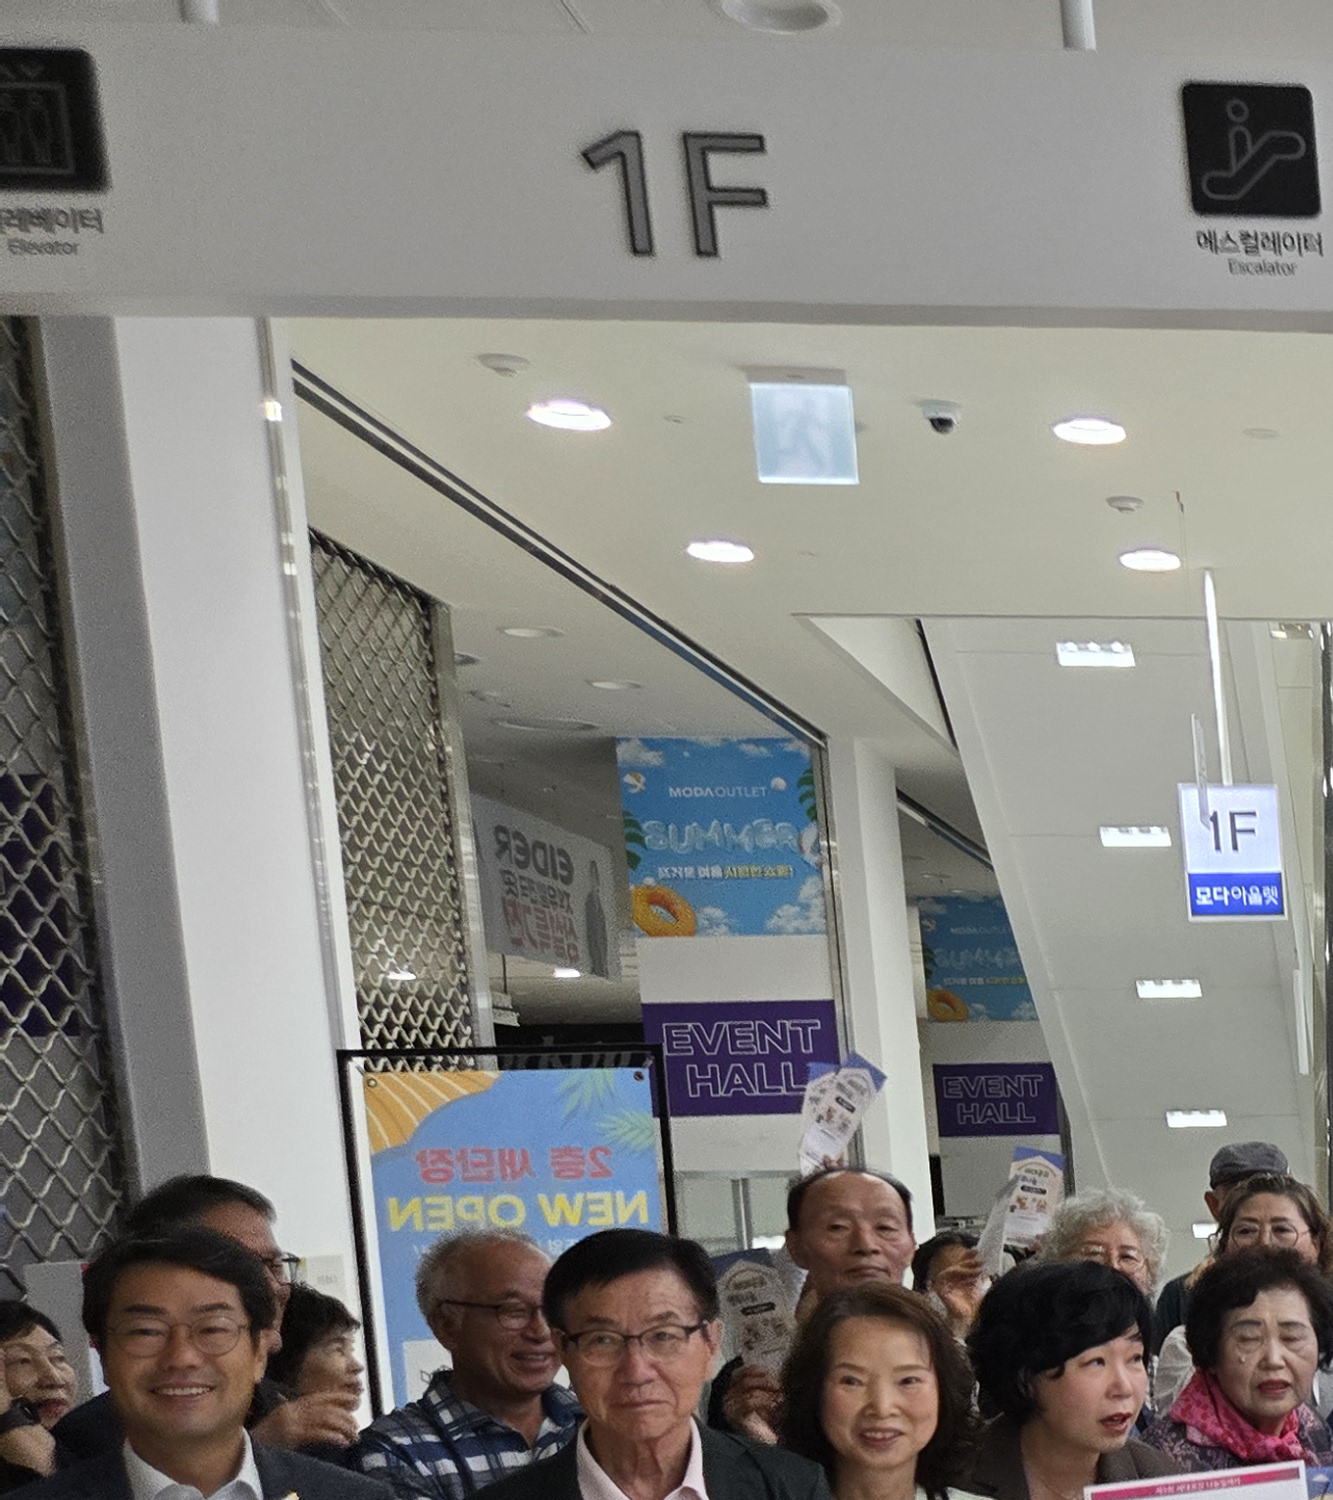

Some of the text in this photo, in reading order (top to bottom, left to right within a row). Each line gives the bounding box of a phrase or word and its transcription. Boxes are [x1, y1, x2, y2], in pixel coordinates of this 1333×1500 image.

[580, 129, 769, 258] 1F
[1197, 229, 1324, 257] 에스컬레이터
[1228, 257, 1298, 277] Escalator
[643, 818, 799, 854] SUMMER
[1209, 810, 1258, 852] 1F
[1195, 885, 1279, 907] 모다아울렛
[662, 1018, 822, 1056] EVENT
[686, 1061, 808, 1098] HALL
[942, 1074, 1044, 1099] EVENT
[956, 1101, 1036, 1125] HALL
